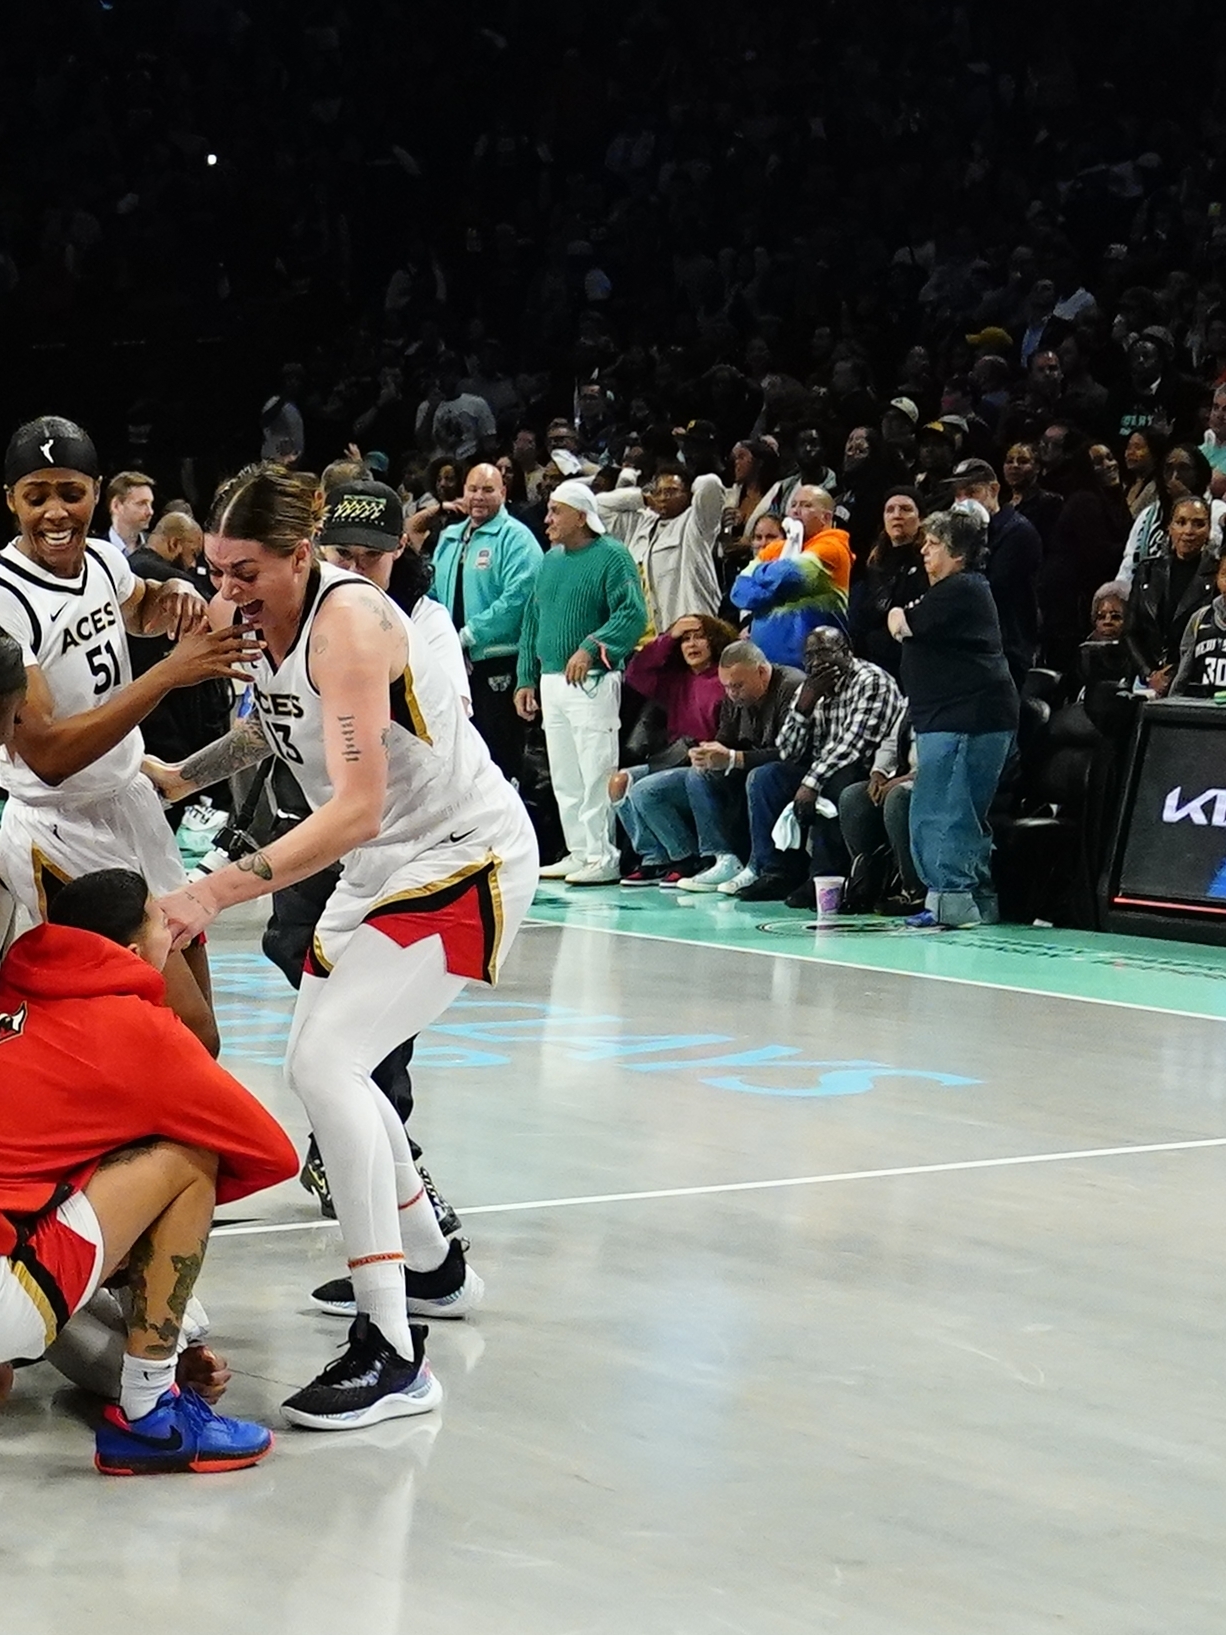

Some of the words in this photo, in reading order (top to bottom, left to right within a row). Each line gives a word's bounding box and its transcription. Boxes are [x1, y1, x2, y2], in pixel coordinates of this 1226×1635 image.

[61, 601, 116, 656] ACES
[85, 639, 121, 695] 51
[1202, 656, 1226, 687] 30
[1162, 786, 1226, 826] KI
